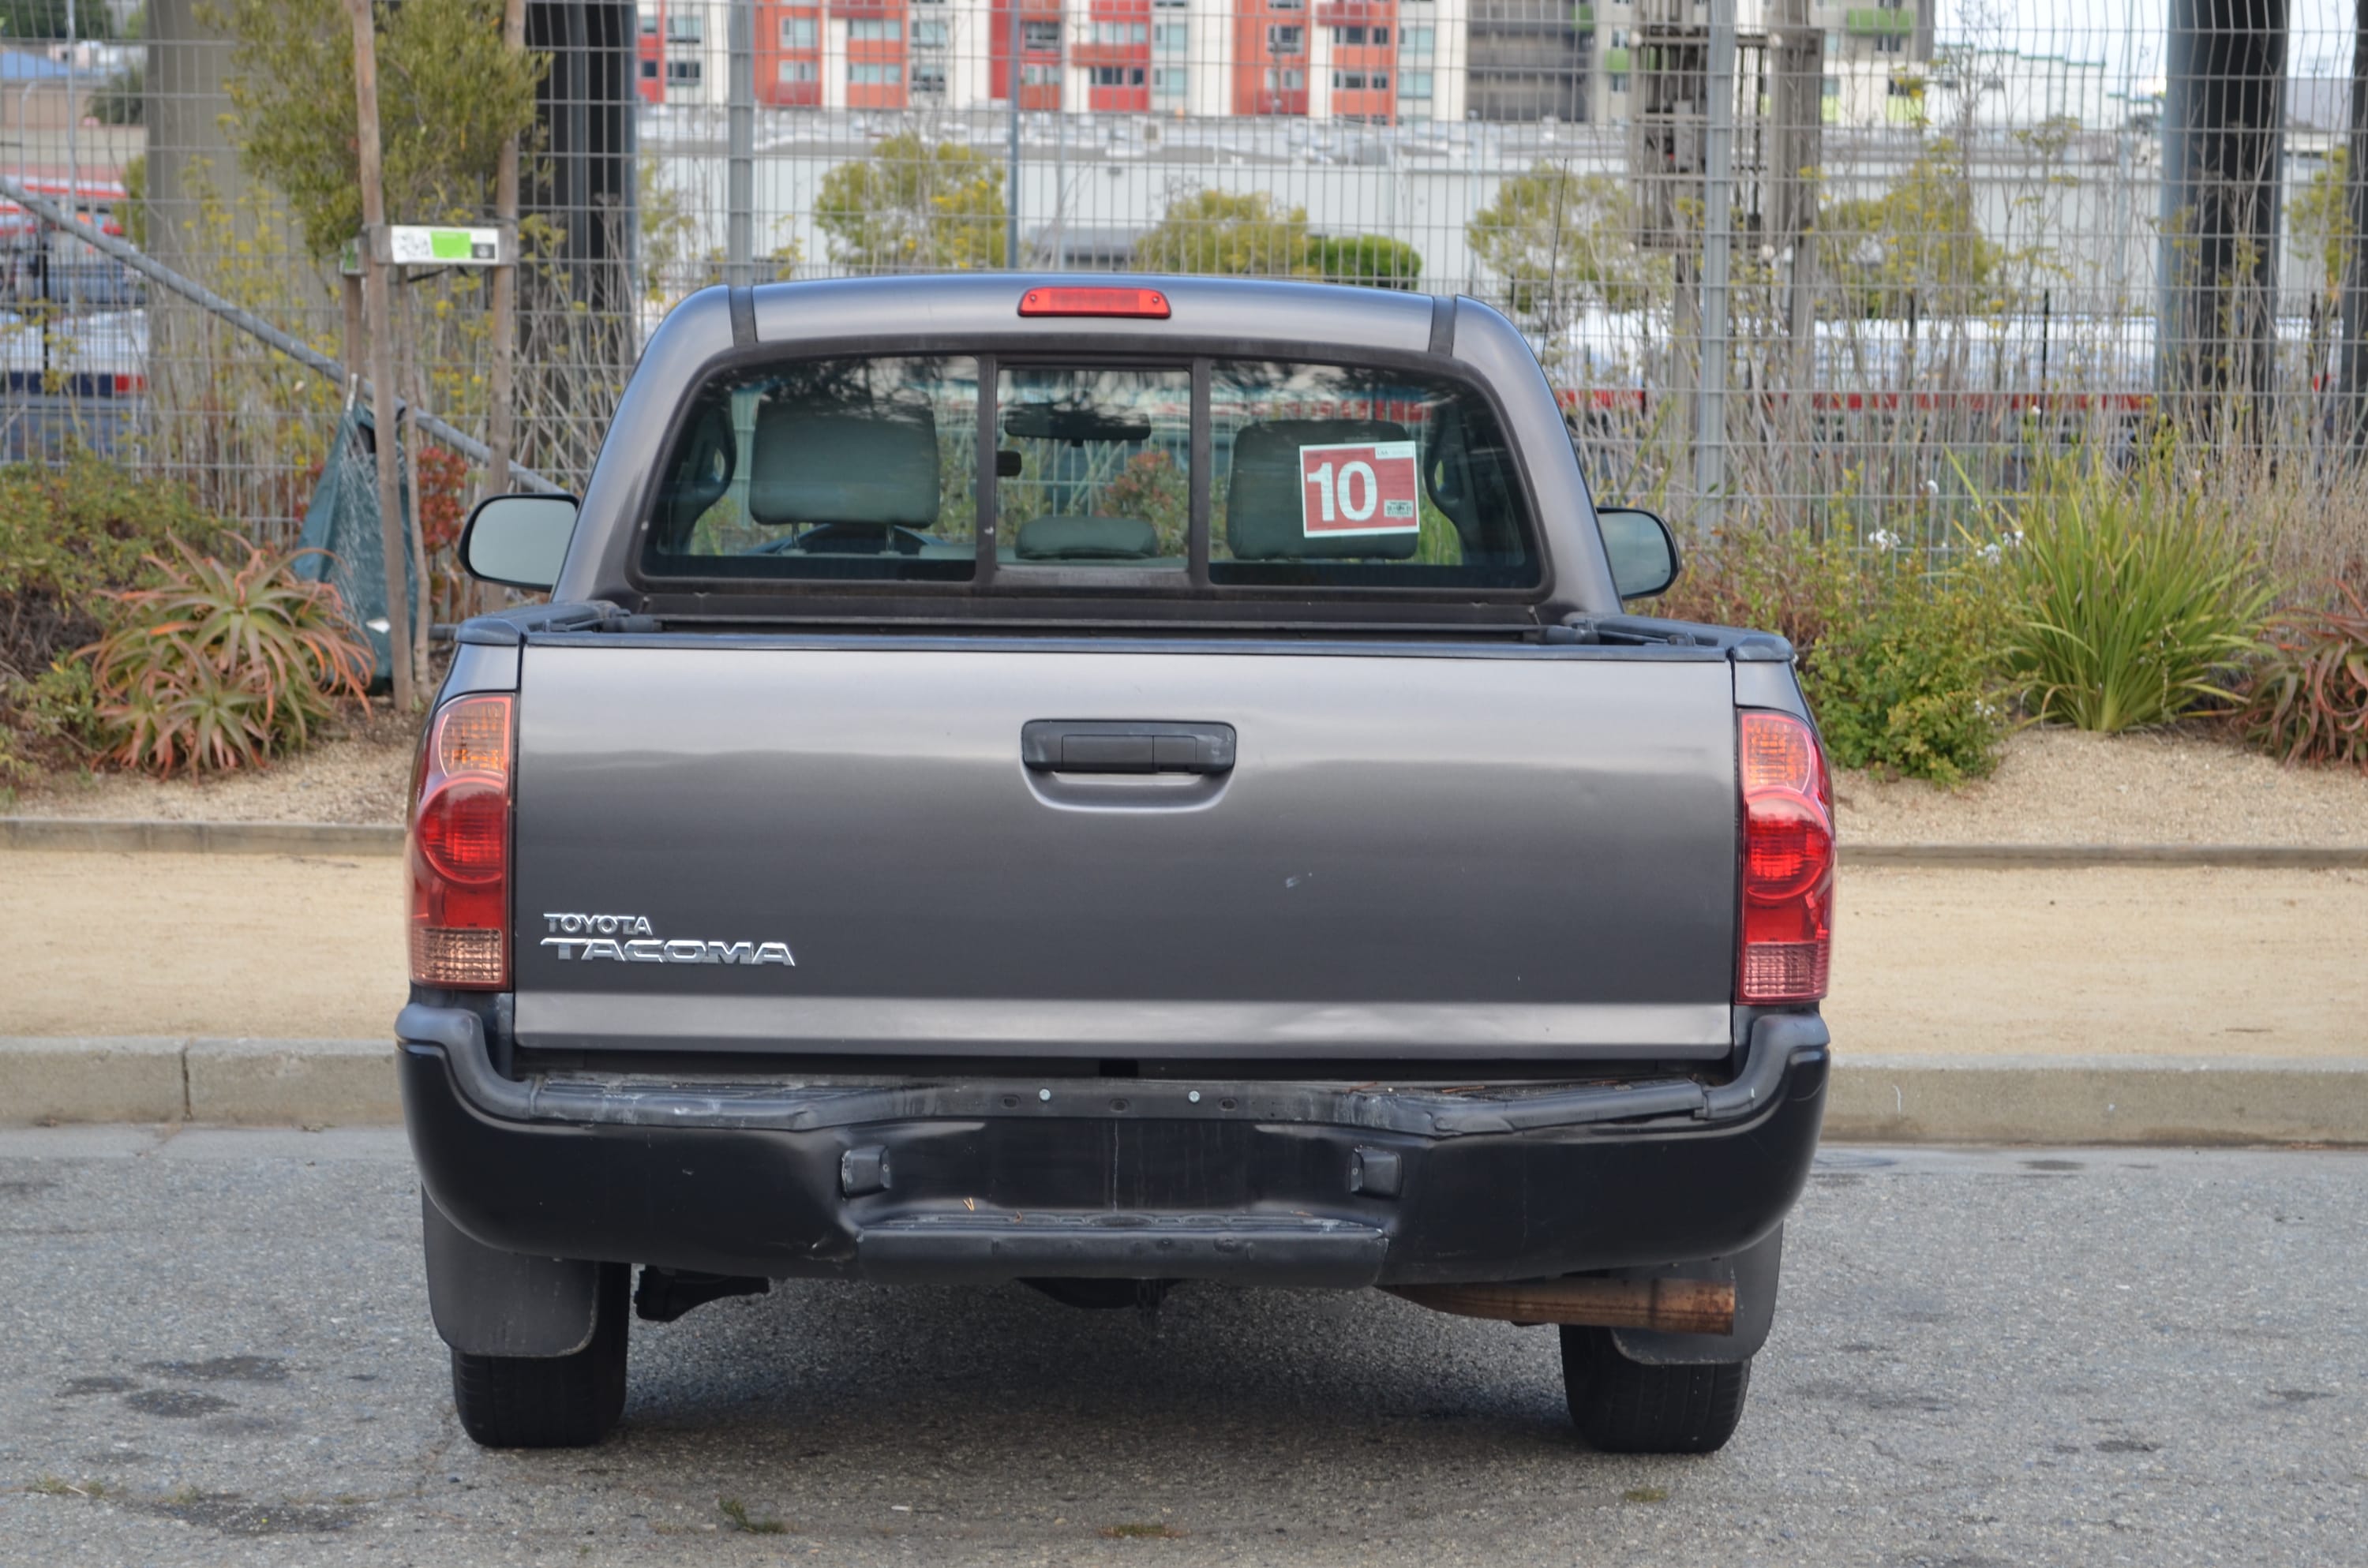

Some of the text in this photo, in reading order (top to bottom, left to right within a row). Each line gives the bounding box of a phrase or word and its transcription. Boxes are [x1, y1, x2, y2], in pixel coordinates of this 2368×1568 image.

[1306, 460, 1377, 522] 10
[543, 913, 653, 935] TOYOTA
[540, 937, 795, 967] TACOMA
